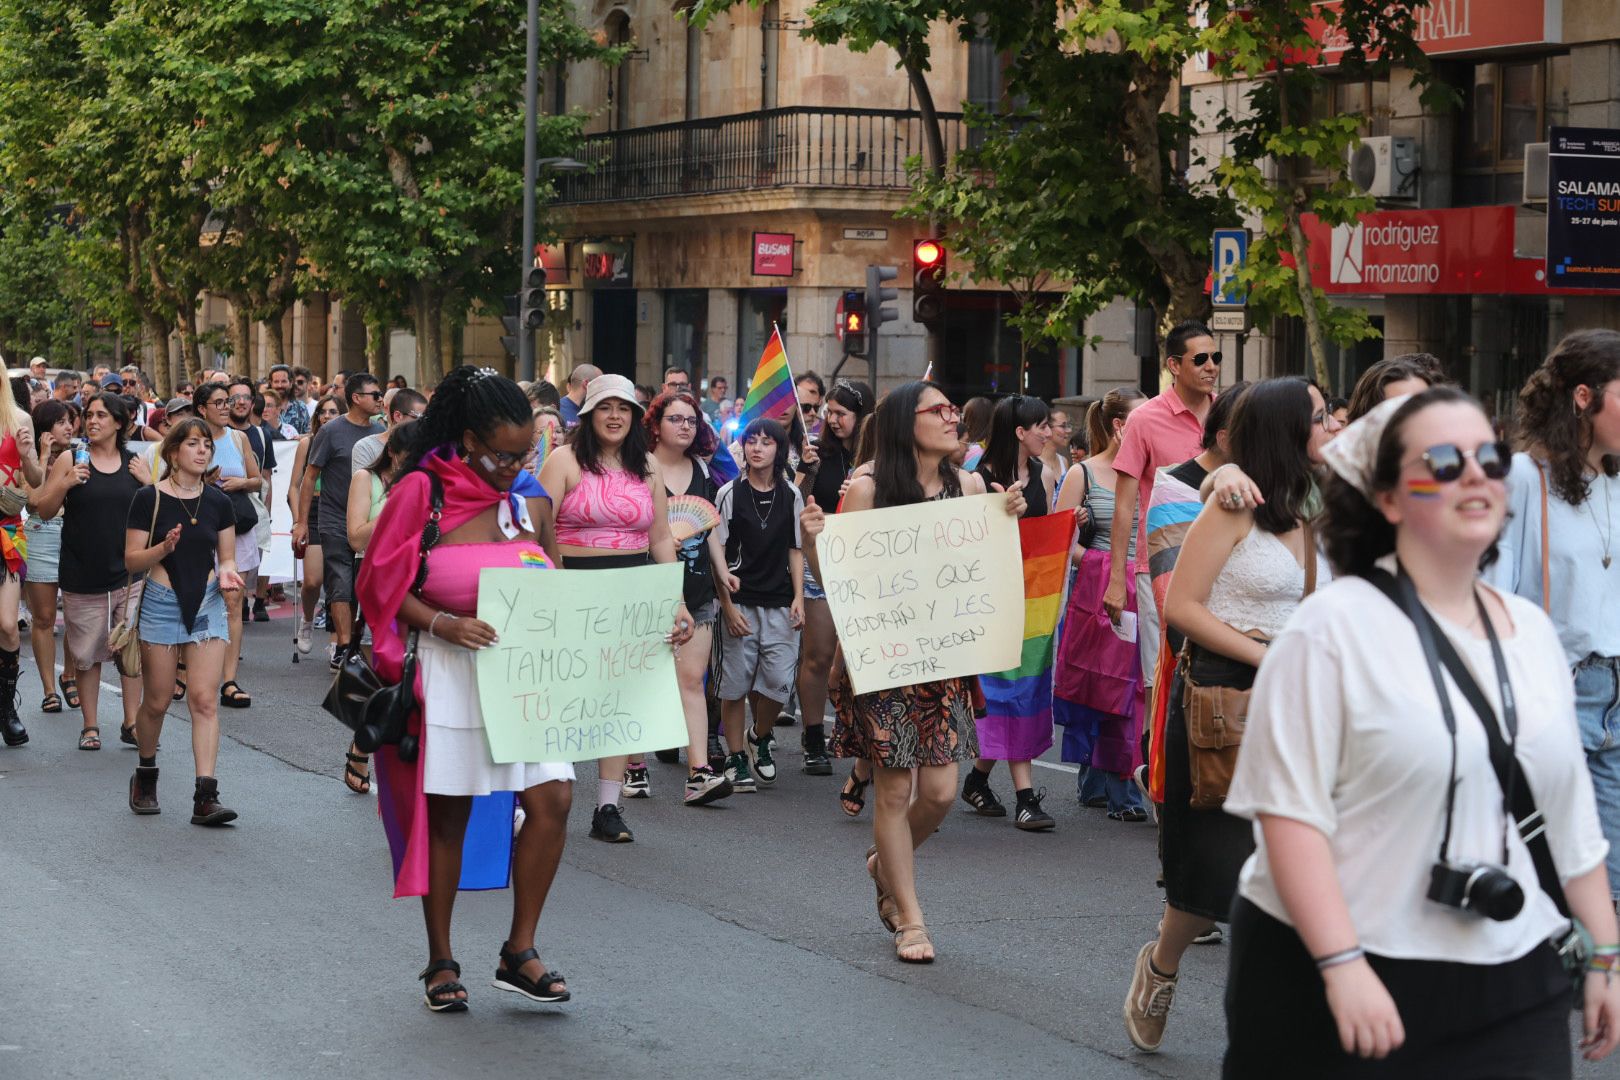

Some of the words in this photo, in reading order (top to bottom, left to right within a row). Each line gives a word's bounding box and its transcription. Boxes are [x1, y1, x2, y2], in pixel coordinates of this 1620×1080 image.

[1557, 197, 1597, 211] TECH
[1598, 198, 1620, 212] SU
[1365, 220, 1439, 251] rodríguez
[1571, 217, 1591, 225] 25-27
[1592, 217, 1601, 226] de
[1601, 217, 1618, 227] junio
[758, 242, 791, 256] BUSAN
[1219, 237, 1240, 297] P
[1364, 263, 1439, 283] manzano
[820, 534, 846, 566] YO
[854, 524, 921, 559] ESTOY
[933, 505, 991, 549] AQUÍ
[830, 577, 866, 607] POR
[877, 569, 919, 599] LES
[936, 559, 986, 589] QUE
[498, 588, 520, 633] Y
[527, 608, 558, 638] SI
[576, 606, 612, 642] TE
[926, 599, 937, 621] Y
[953, 594, 996, 619] LES
[880, 643, 909, 660] NO
[916, 624, 986, 655] PUEDEN
[501, 646, 588, 685] TAMOS
[888, 657, 946, 680] ESTAR
[513, 688, 552, 722] TÚ
[545, 719, 642, 755] ARMARIO
